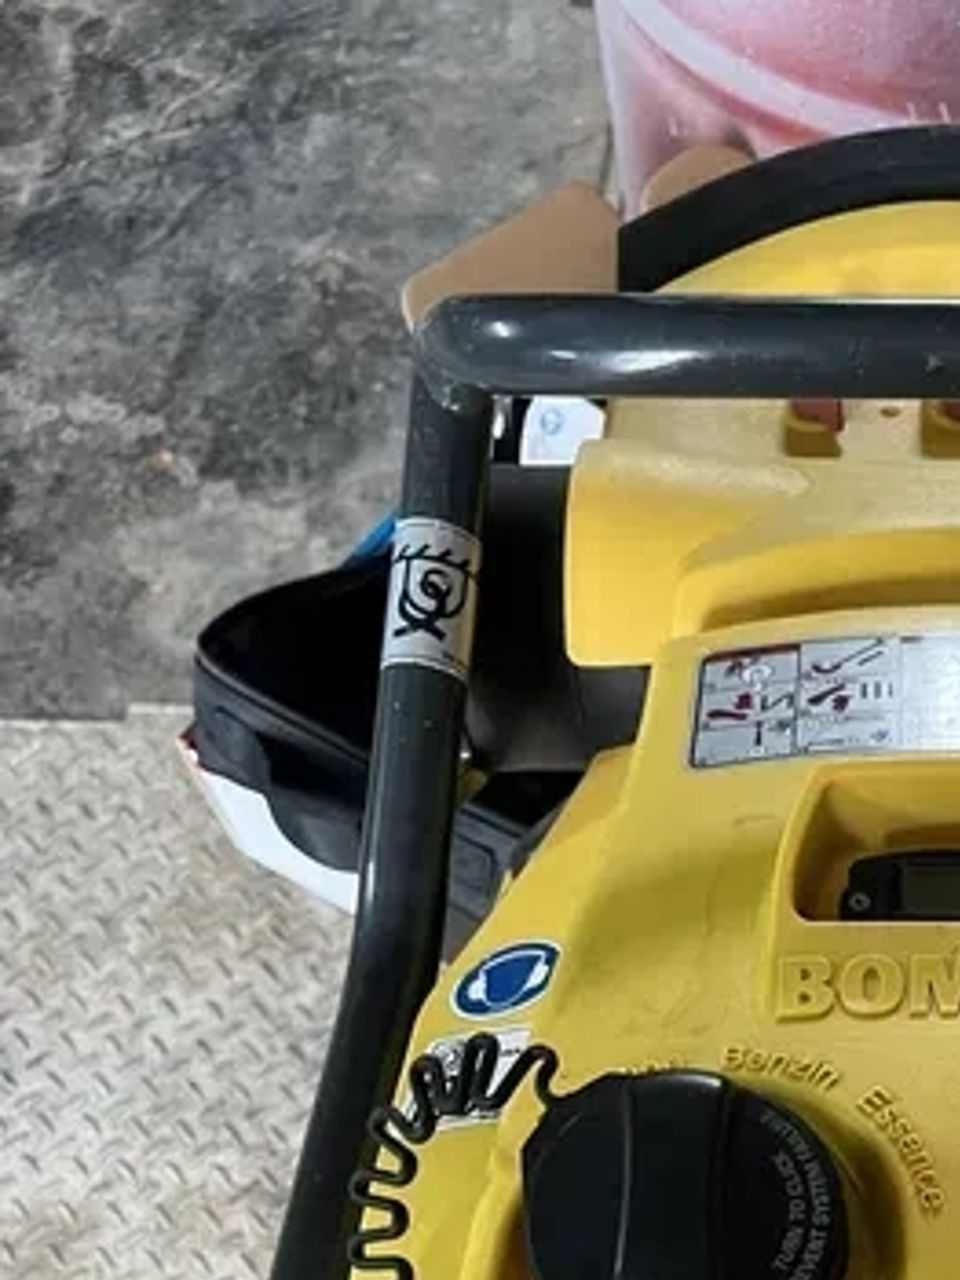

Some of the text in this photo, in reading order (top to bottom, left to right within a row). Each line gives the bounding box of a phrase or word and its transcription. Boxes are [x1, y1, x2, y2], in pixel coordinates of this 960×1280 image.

[722, 1044, 842, 1090] Benzin
[856, 1085, 948, 1221] Essence
[770, 1226, 805, 1272] TURN
[788, 1198, 806, 1222] TO
